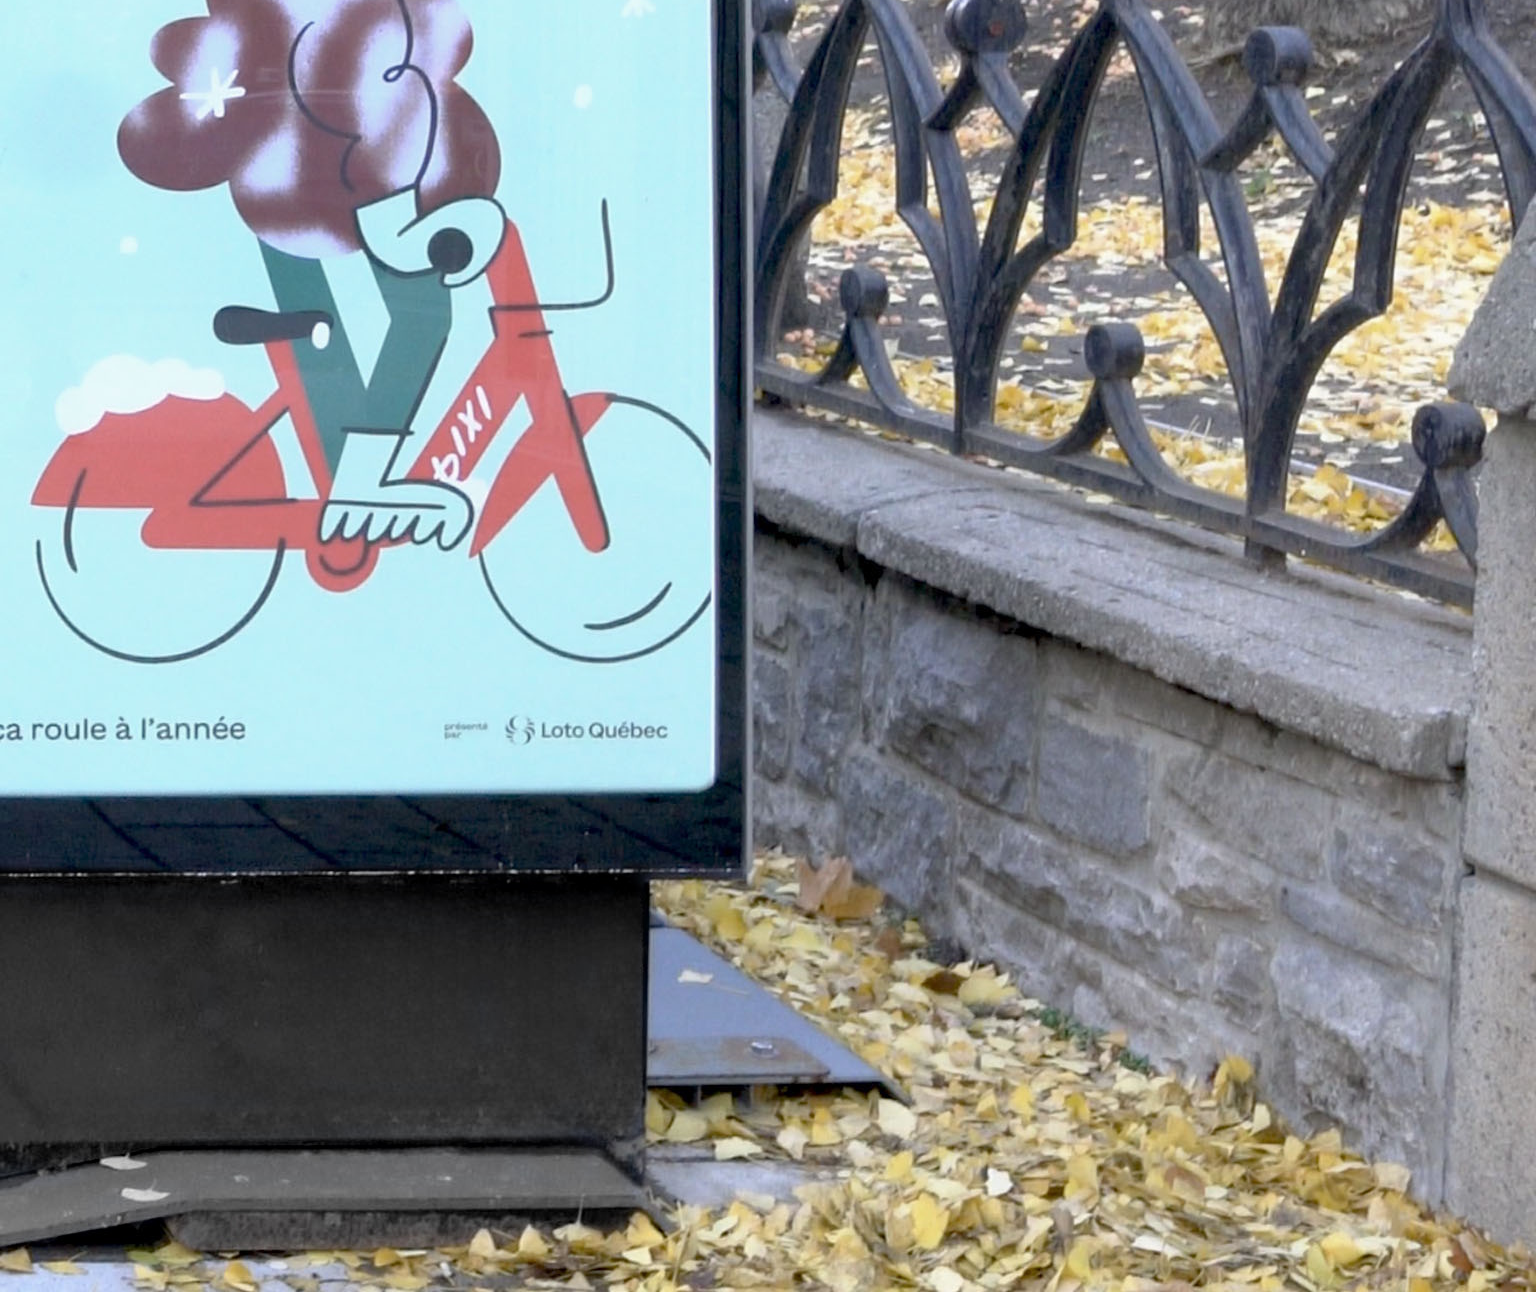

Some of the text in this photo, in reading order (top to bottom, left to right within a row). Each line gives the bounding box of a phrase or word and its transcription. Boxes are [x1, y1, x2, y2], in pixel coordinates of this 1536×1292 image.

[31, 718, 107, 741] roule
[115, 716, 133, 741] à
[141, 715, 246, 741] l'année
[541, 721, 669, 739] Loto Québec
